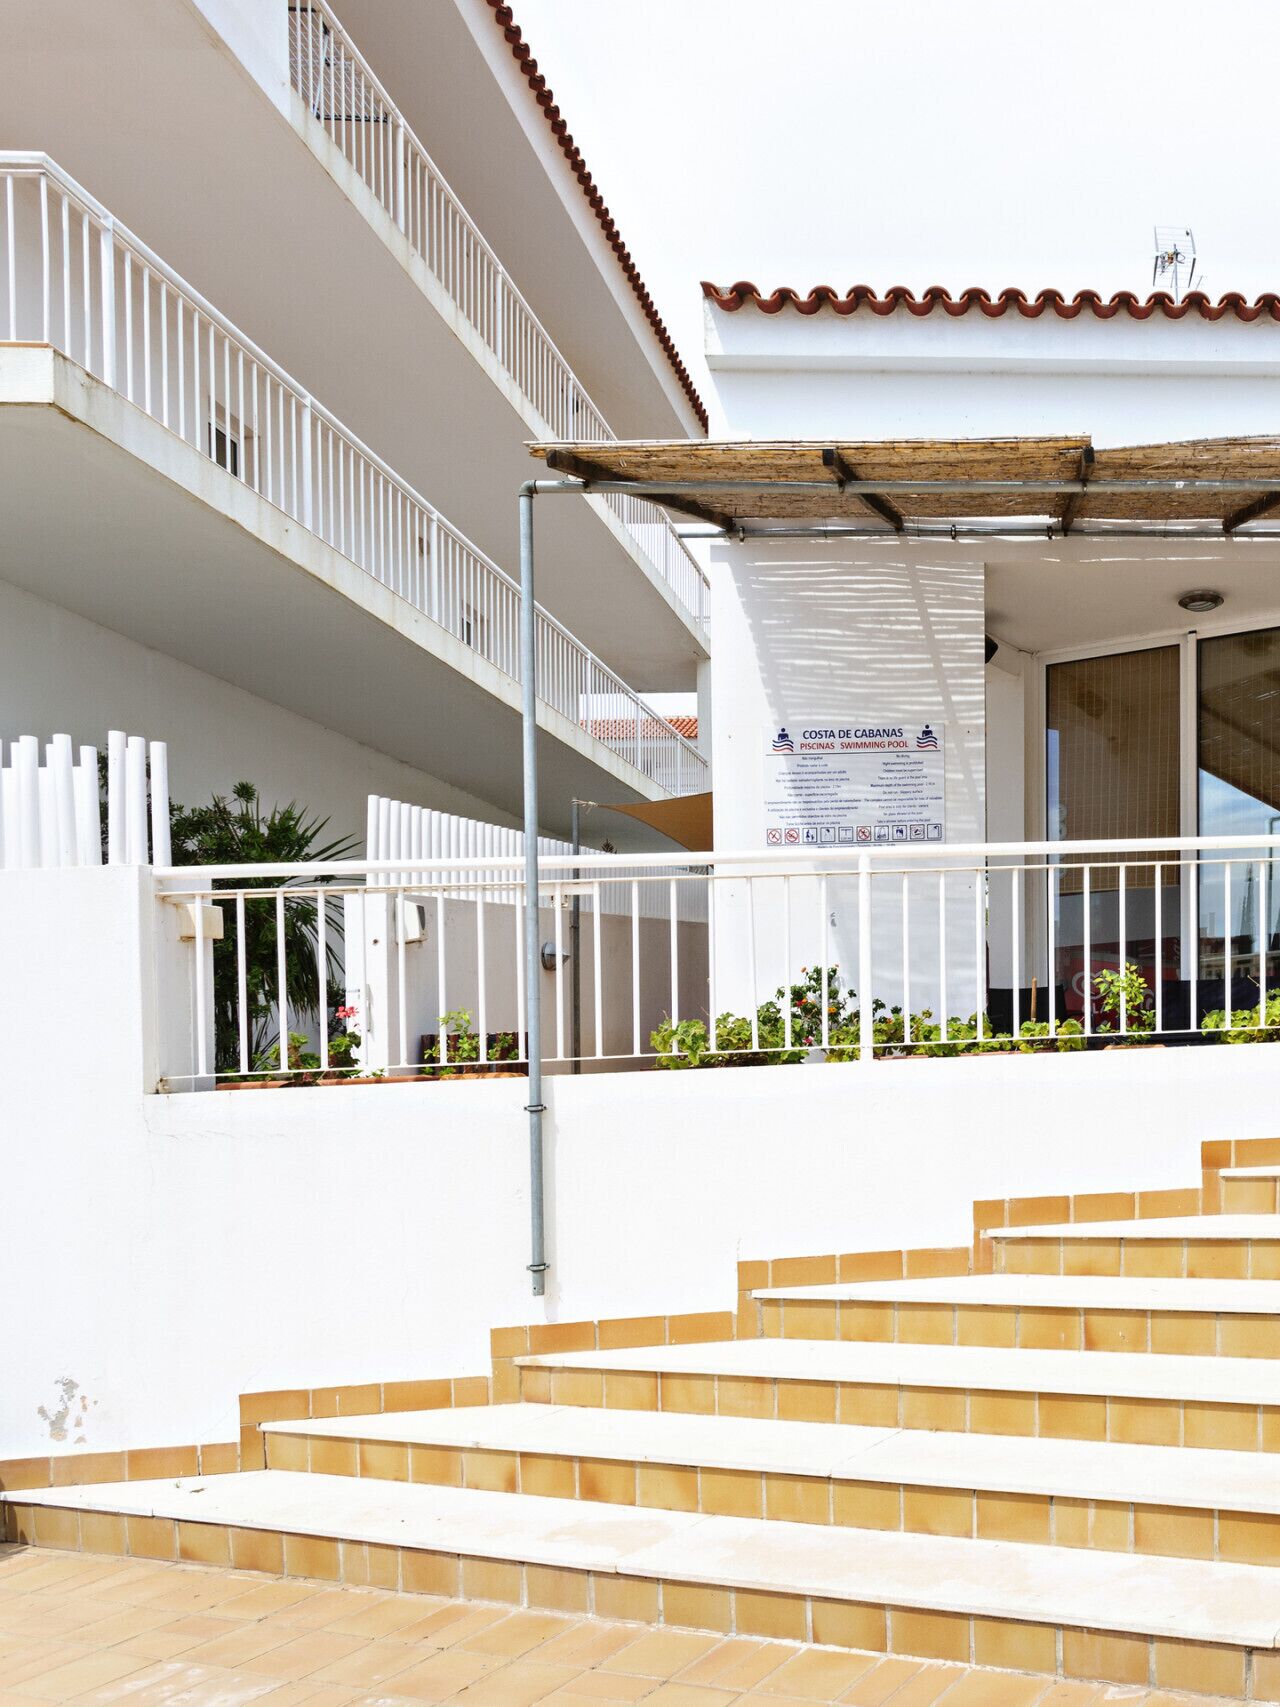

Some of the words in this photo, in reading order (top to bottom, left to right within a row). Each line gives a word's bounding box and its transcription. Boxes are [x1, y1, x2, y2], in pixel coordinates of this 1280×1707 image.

[803, 730, 836, 740] COSTA
[838, 729, 852, 739] DE
[854, 728, 903, 738] CABANAS
[800, 742, 835, 750] PISCINAS
[840, 741, 886, 749] SWIMMING
[887, 740, 909, 748] POOL
